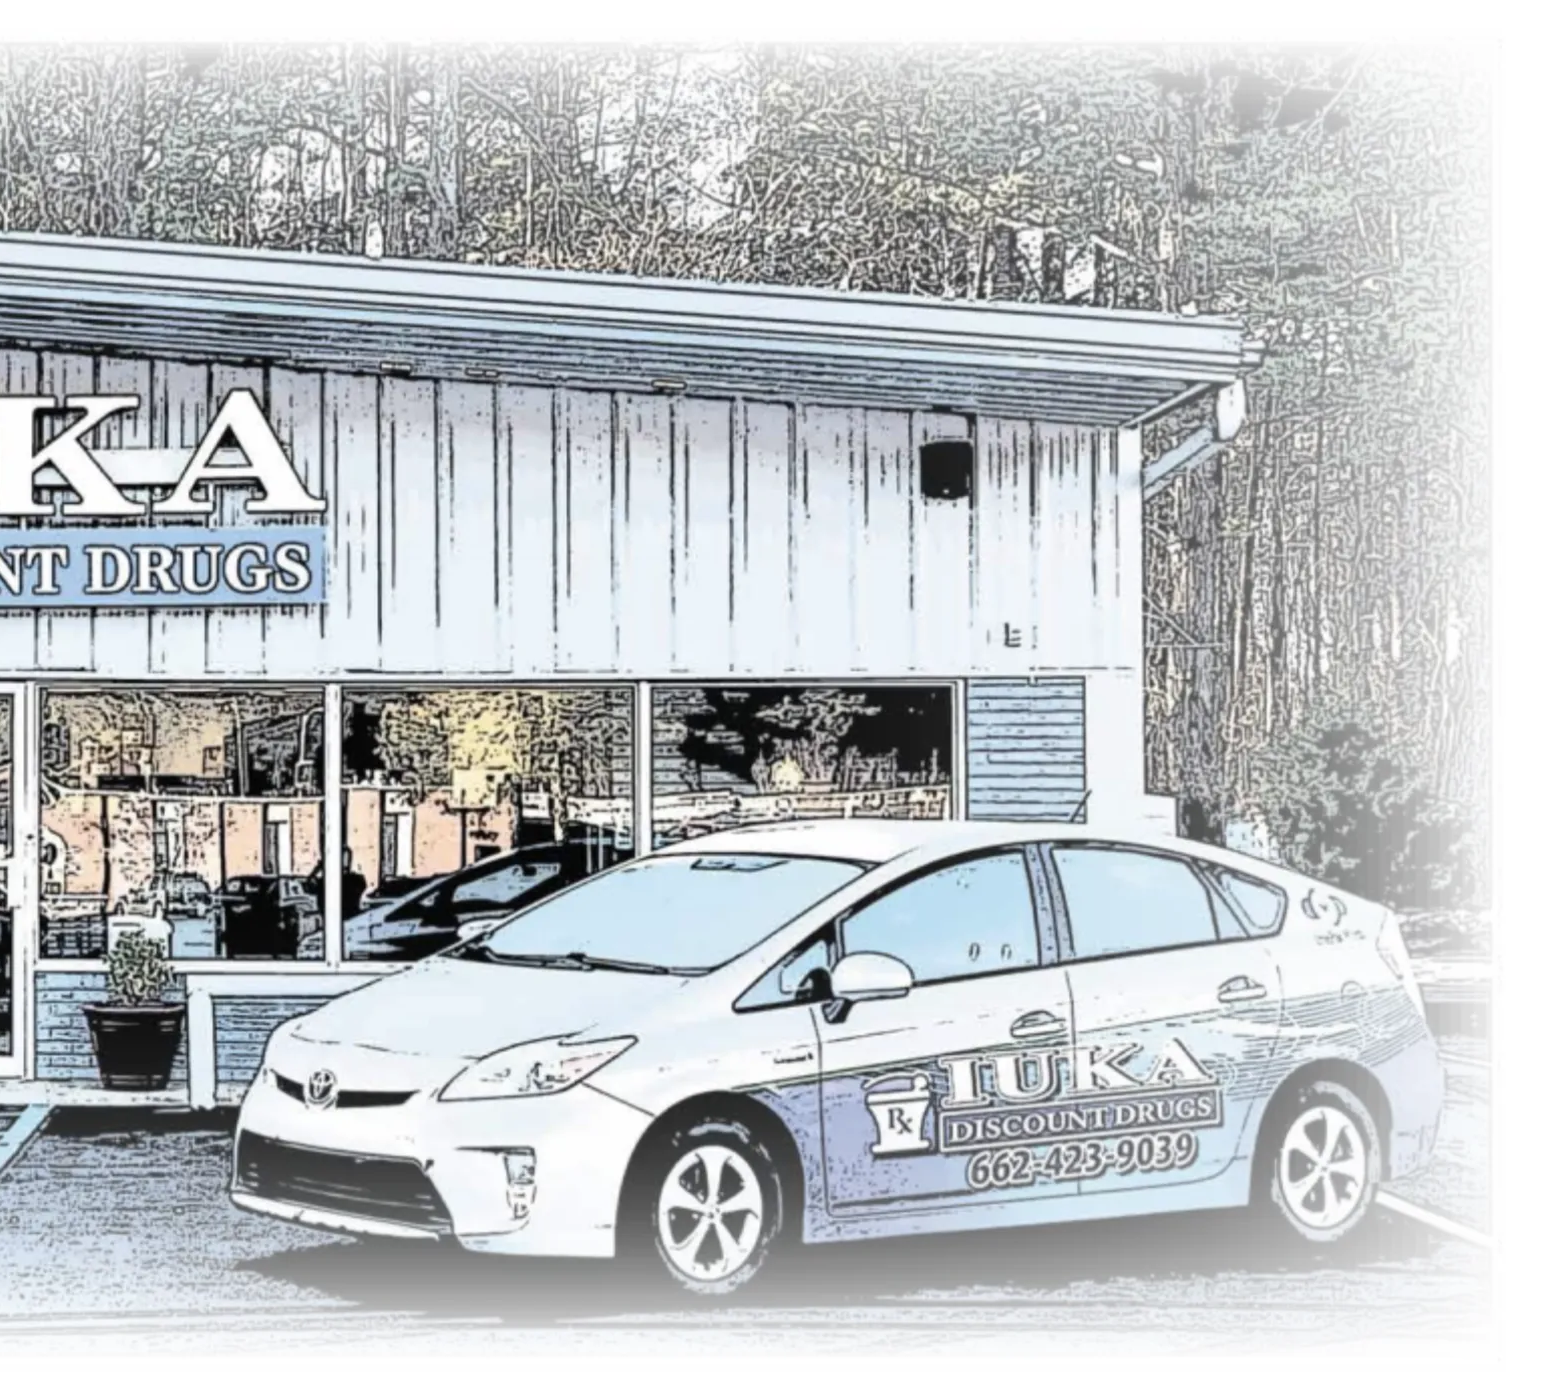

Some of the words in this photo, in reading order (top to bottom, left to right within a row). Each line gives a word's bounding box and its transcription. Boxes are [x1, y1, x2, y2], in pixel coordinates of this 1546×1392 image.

[86, 542, 314, 597] DRUGS
[940, 1037, 1217, 1109] IUKA
[949, 1104, 1107, 1143] DISCOUNT
[1114, 1097, 1212, 1124] DRUGS
[969, 1132, 1198, 1188] 662-423-9039
